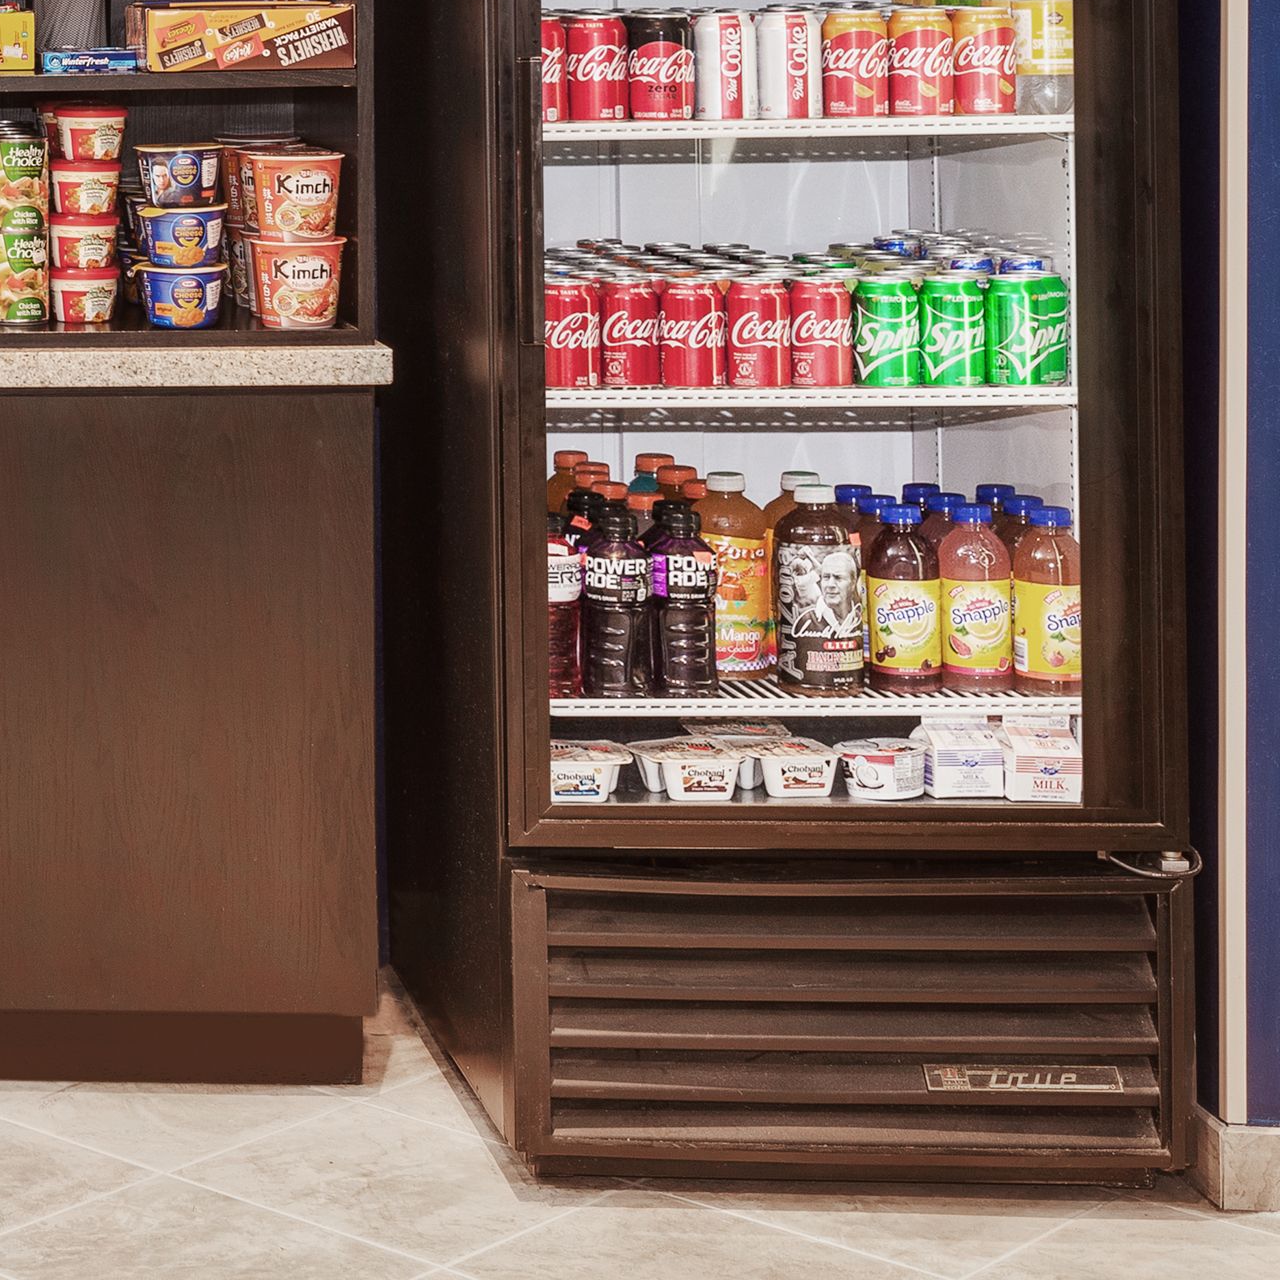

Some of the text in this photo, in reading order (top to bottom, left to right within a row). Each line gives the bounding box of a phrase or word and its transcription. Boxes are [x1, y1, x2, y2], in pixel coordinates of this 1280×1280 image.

[277, 25, 348, 67] HERSHEY'S
[61, 56, 109, 67] Winterfresh
[721, 26, 741, 101] Diet Coke
[787, 26, 808, 100] Diet Coke
[648, 84, 677, 93] zero
[10, 145, 44, 158] Healthy
[3, 156, 43, 167] Choice
[275, 174, 334, 194] Kimchi
[13, 210, 36, 218] Chicken
[14, 236, 46, 248] Healthy
[273, 259, 332, 280] Kimchi
[585, 558, 647, 574] POWER
[668, 571, 706, 587] ADE
[876, 600, 935, 626] Snapple
[952, 600, 1009, 625] Snapple
[721, 629, 761, 647] Mango
[688, 768, 725, 779] Chobani
[787, 764, 824, 774] Chobani
[556, 772, 595, 783] Chobani
[1033, 780, 1064, 790] MILK
